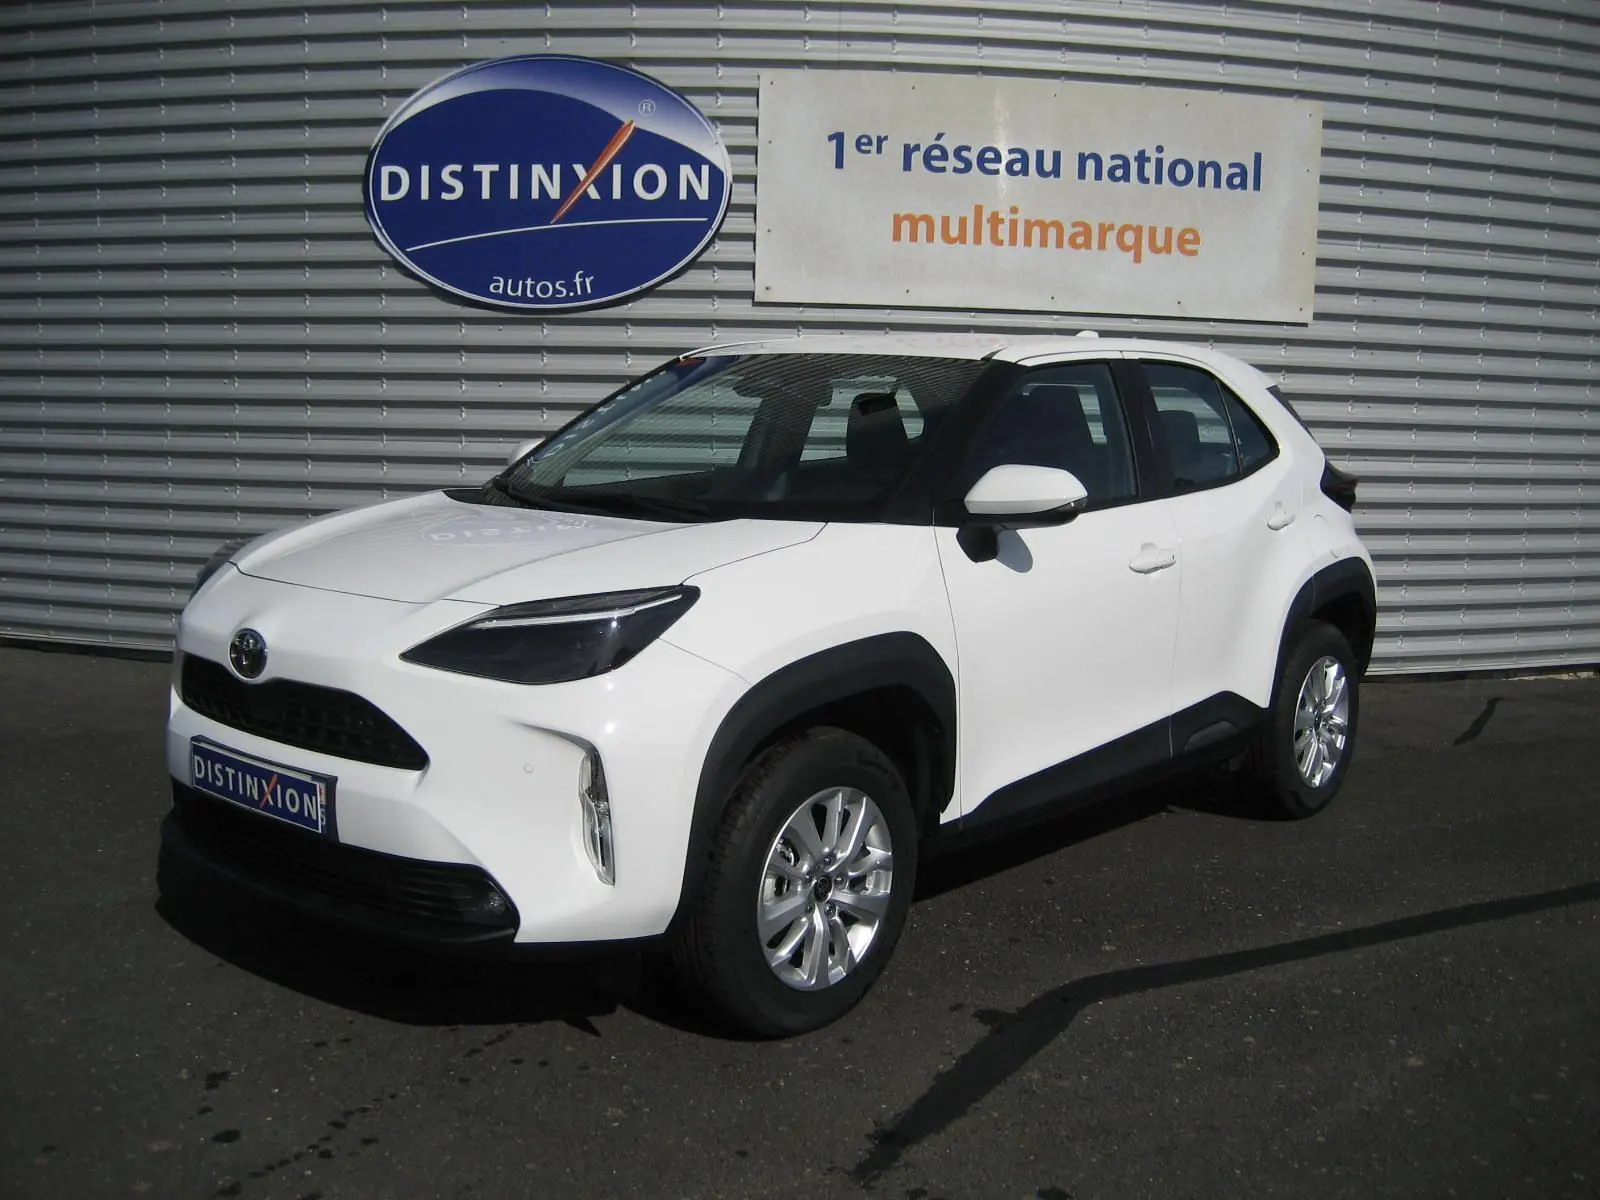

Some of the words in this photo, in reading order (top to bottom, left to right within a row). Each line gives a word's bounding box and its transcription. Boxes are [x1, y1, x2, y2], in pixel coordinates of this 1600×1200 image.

[379, 162, 710, 202] DISTINXION
[827, 131, 889, 169] 1er
[902, 132, 1062, 178] réseau
[1077, 145, 1262, 192] national
[892, 205, 1201, 263] multimarque
[489, 271, 594, 298] autos.fr
[194, 755, 317, 820] DISTINXION
